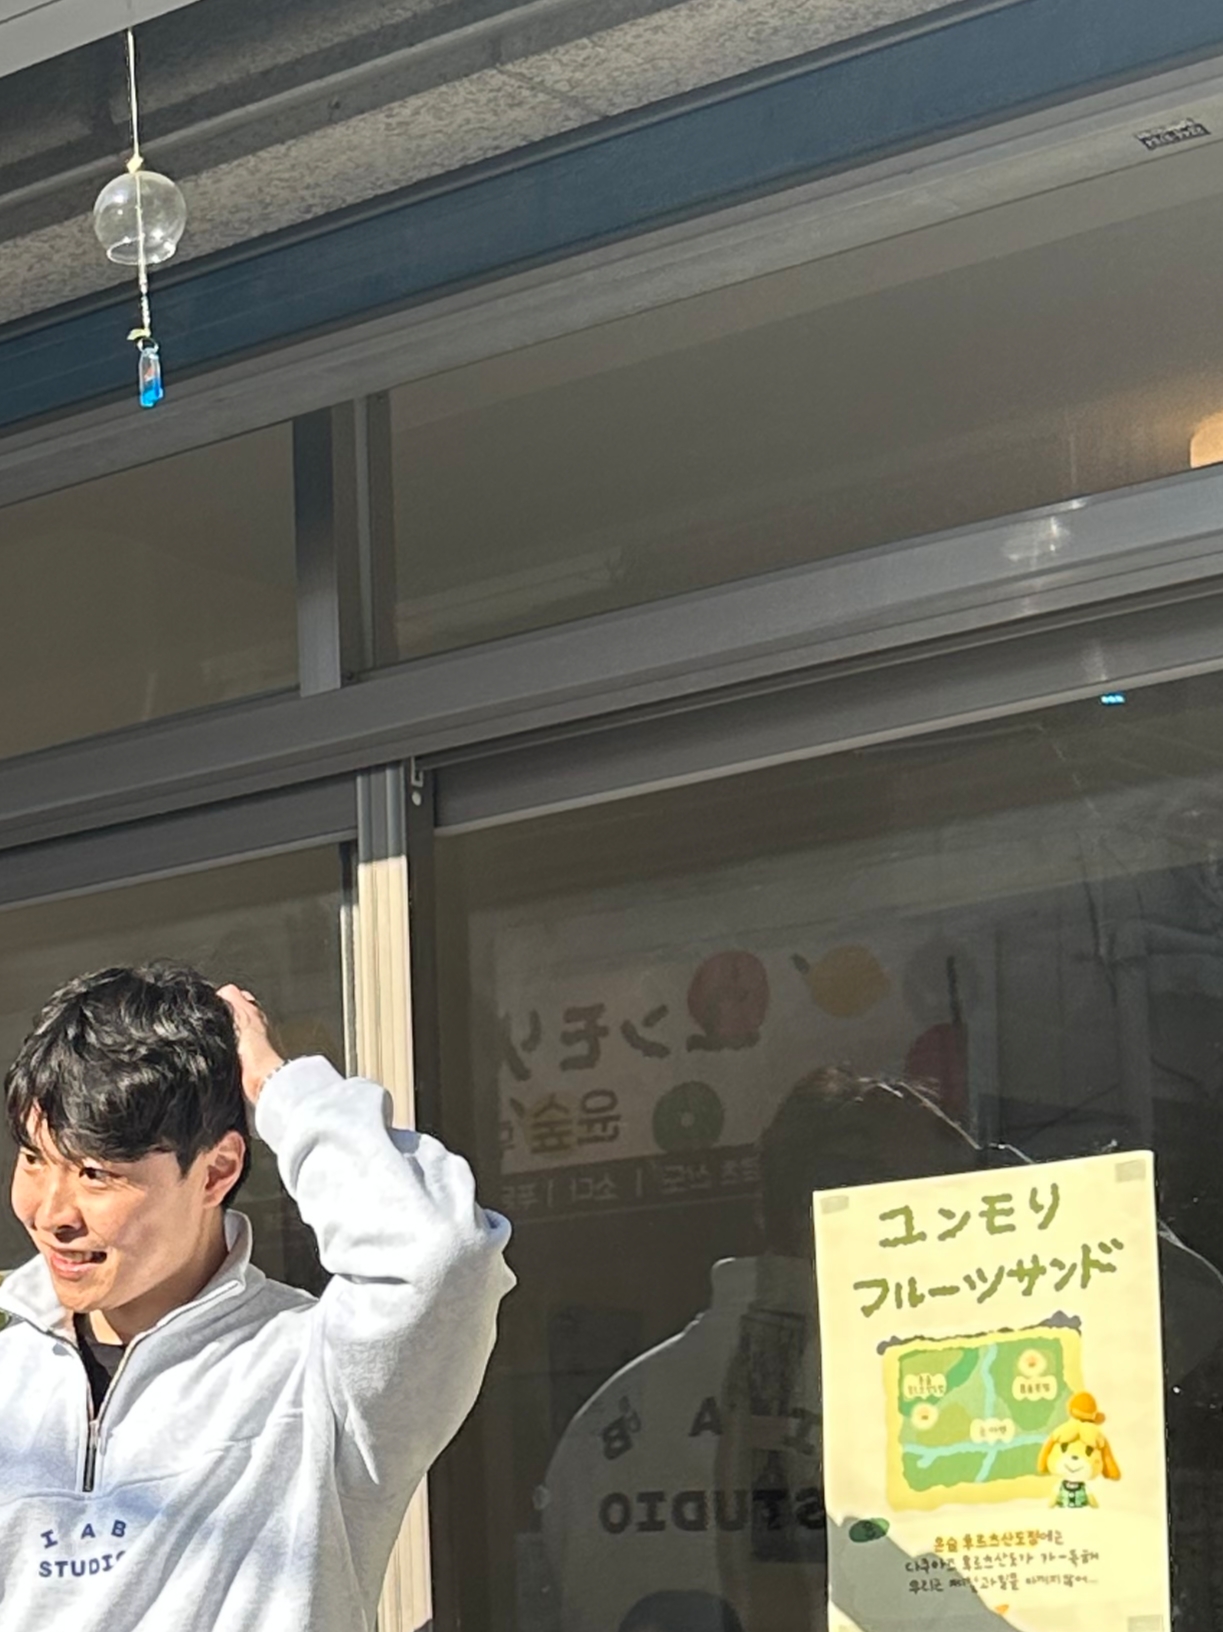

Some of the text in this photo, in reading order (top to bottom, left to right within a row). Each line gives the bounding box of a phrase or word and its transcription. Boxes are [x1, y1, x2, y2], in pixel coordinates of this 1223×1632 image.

[879, 1182, 1060, 1248] ユンモリ
[853, 1238, 1124, 1318] フルーツサンド
[39, 1550, 126, 1578] STUDI
